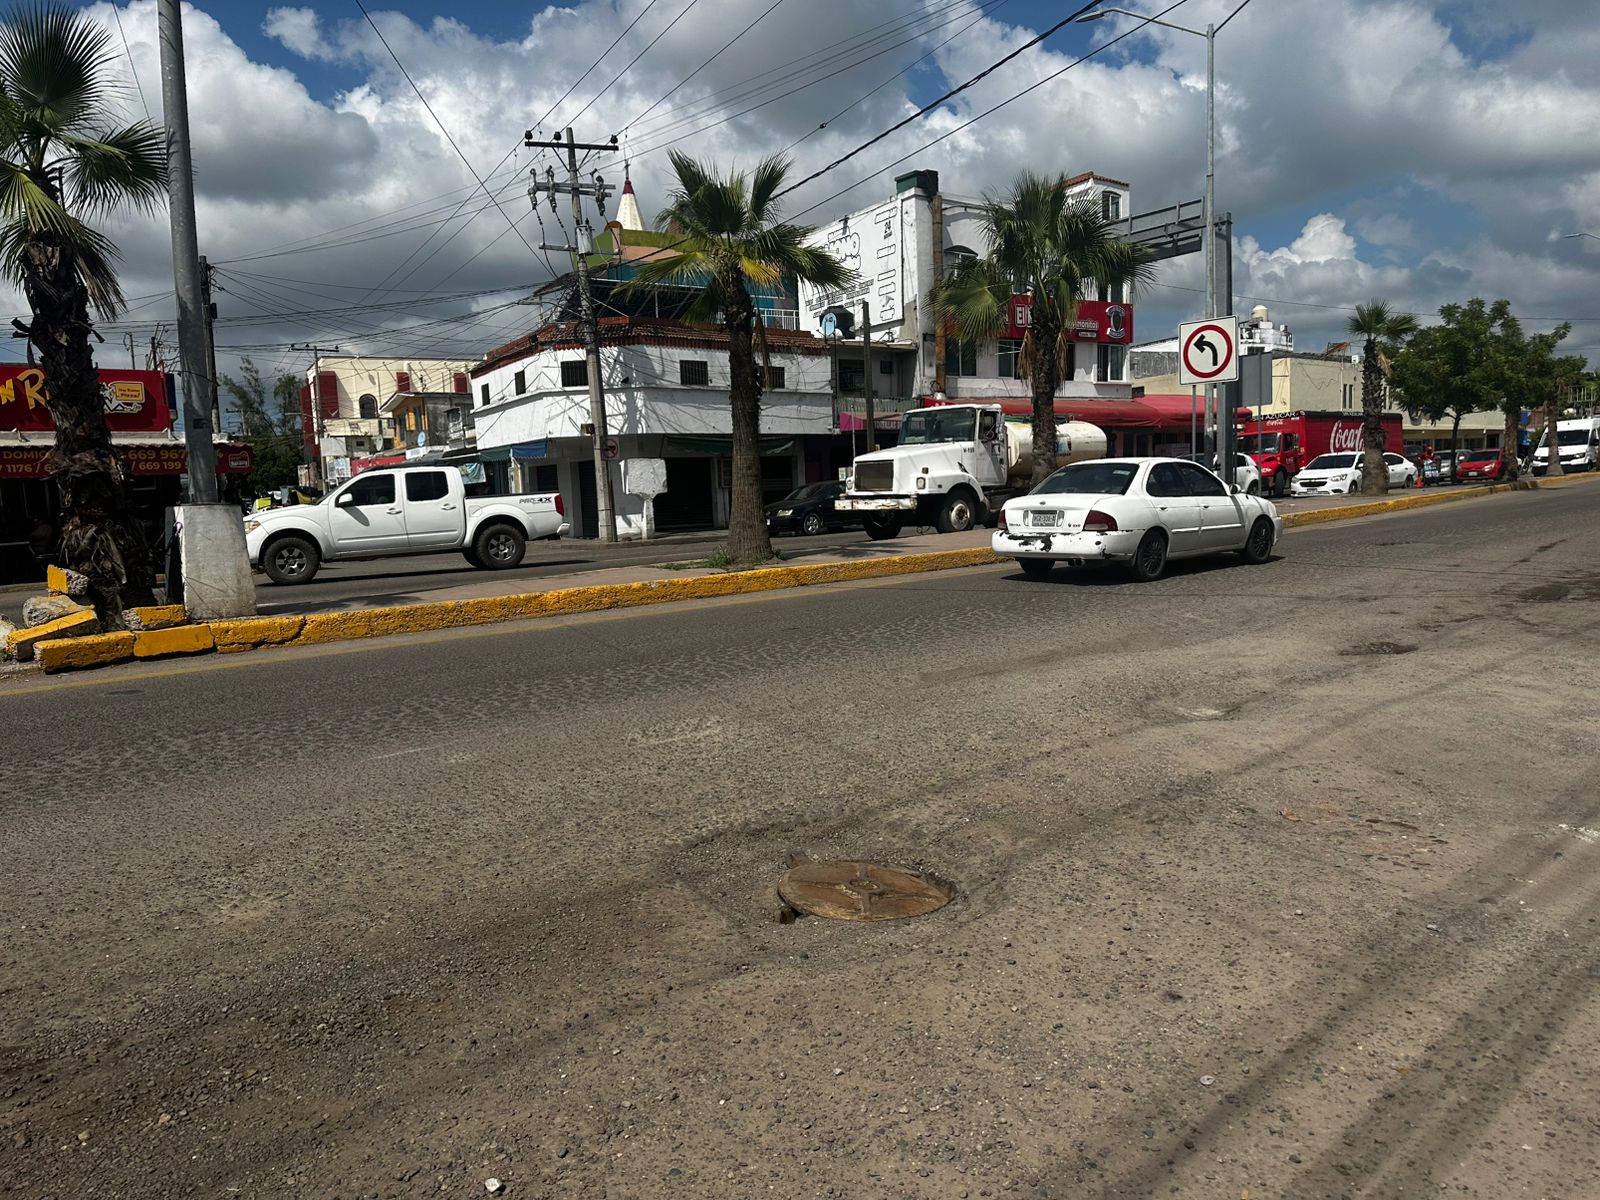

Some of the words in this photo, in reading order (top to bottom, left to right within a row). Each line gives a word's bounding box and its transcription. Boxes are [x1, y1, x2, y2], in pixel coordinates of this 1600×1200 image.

[128, 449, 156, 460] 669
[6, 463, 32, 473] 1176
[138, 461, 160, 470] 669
[163, 461, 182, 470] 199
